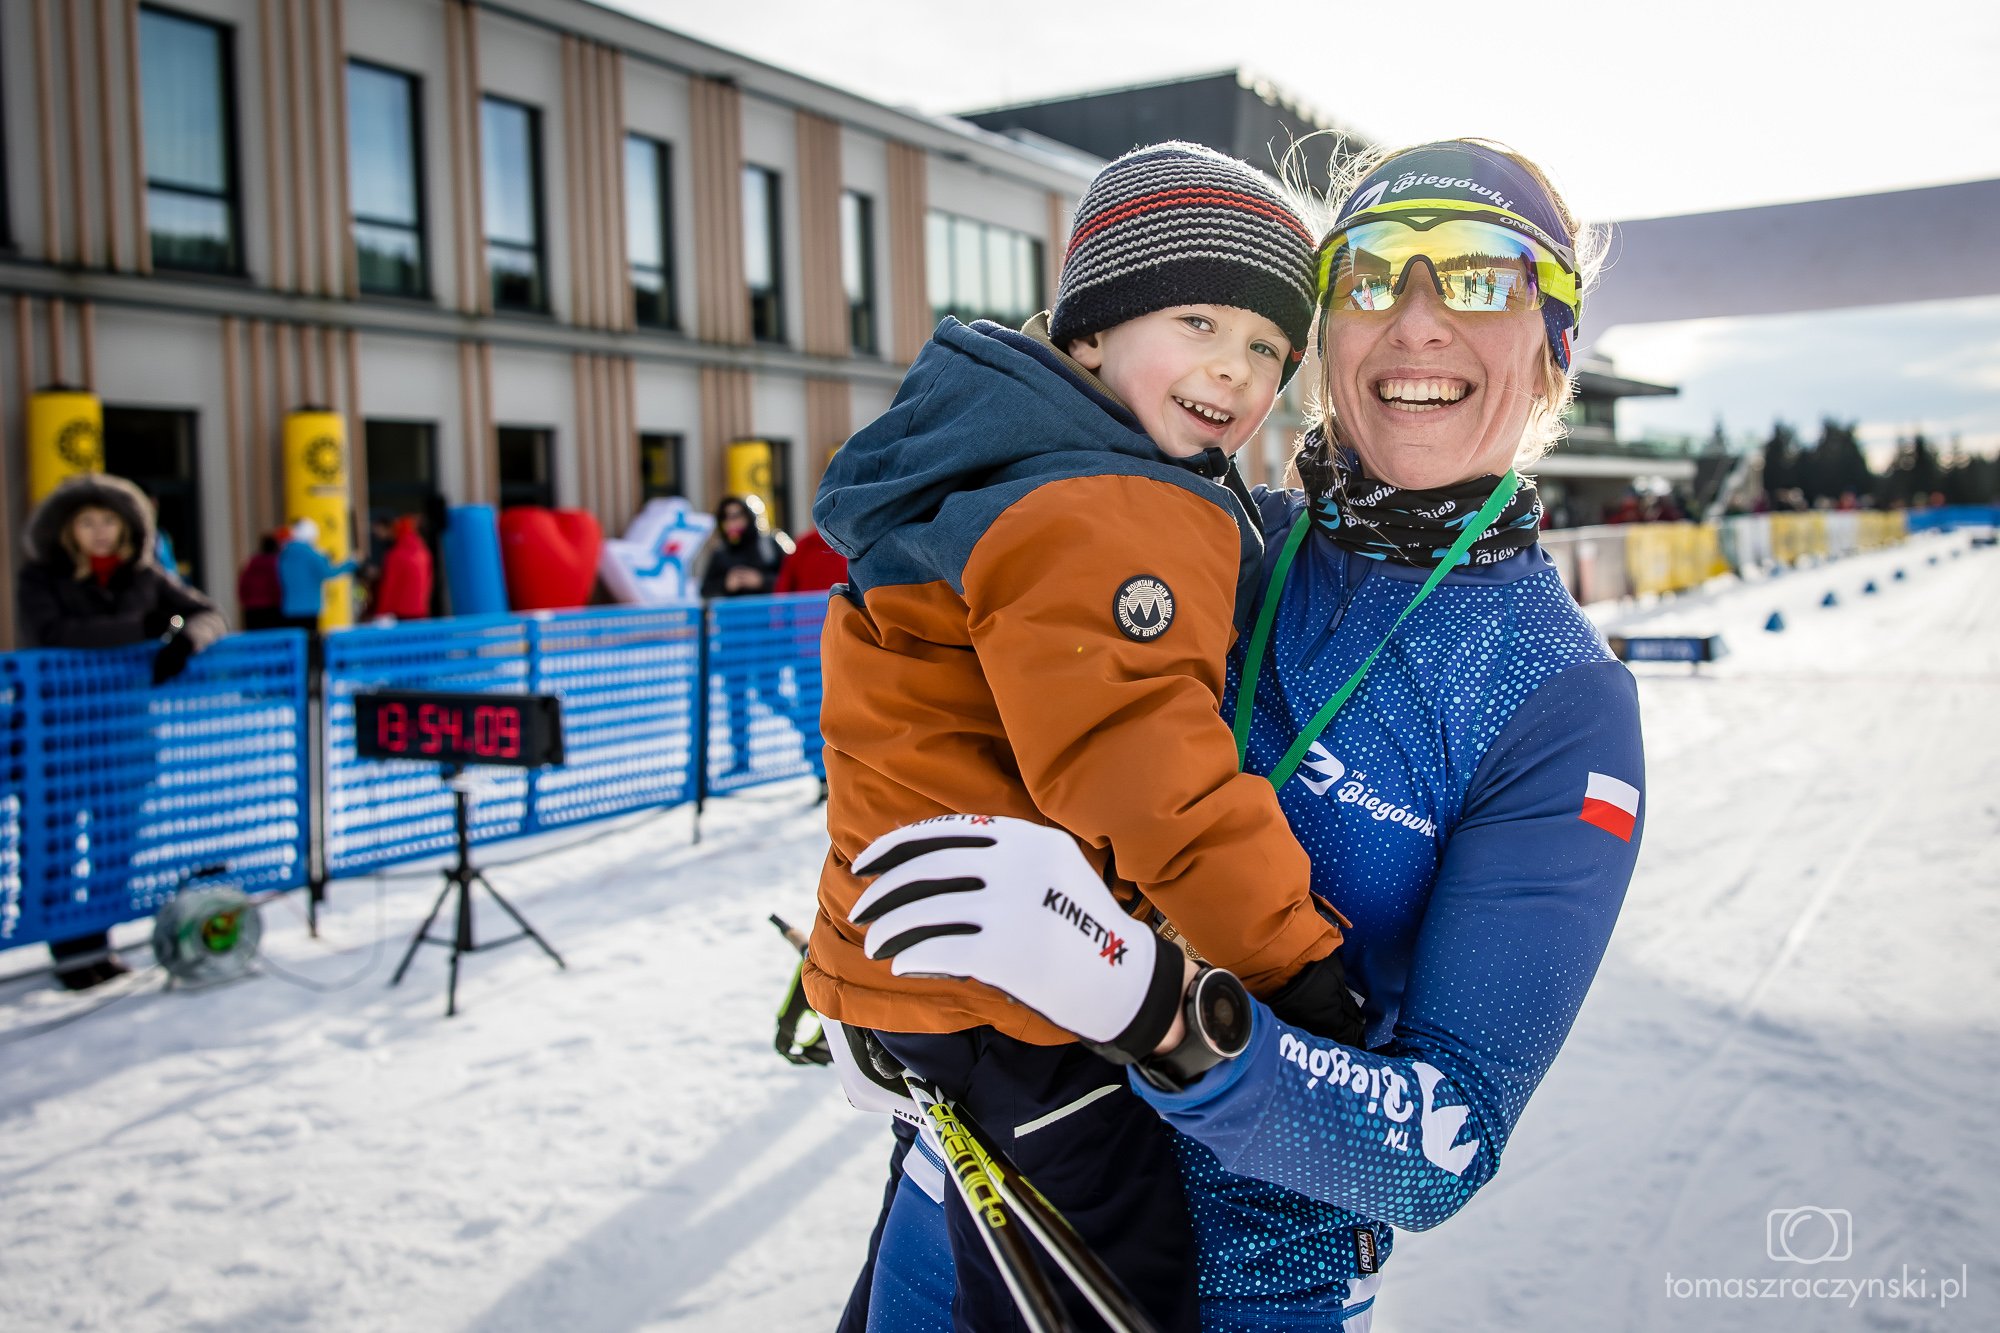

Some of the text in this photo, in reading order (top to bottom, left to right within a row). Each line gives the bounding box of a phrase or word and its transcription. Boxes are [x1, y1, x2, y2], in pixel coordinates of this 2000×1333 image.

[1391, 174, 1515, 211] Biegówki
[1125, 580, 1154, 594] MOUNTAIN
[1119, 594, 1133, 628] ADVENTURE
[1142, 619, 1168, 636] EXPLORER
[1351, 769, 1367, 781] TN
[1360, 1232, 1371, 1269] FORZA
